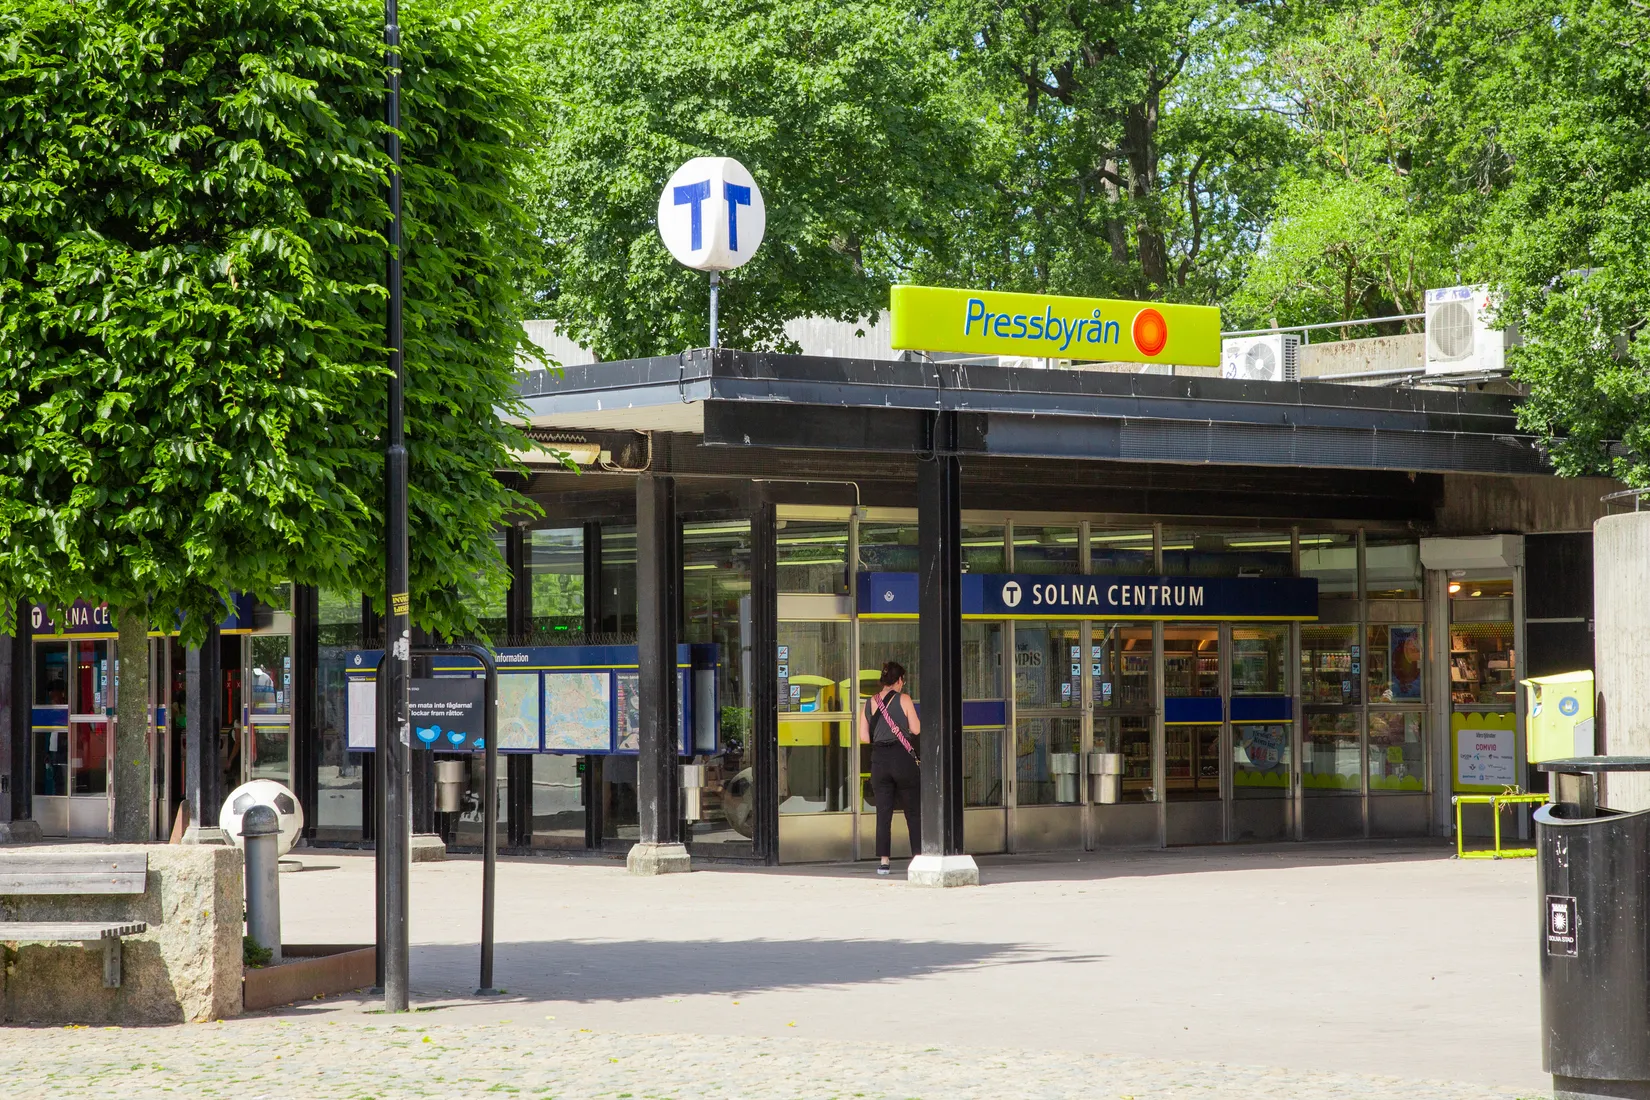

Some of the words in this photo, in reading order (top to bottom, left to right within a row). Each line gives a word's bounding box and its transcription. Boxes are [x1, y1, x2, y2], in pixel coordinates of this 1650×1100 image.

[673, 178, 711, 252] T
[722, 179, 751, 252] T
[964, 298, 1120, 351] Pressbyrån
[1032, 584, 1099, 606] SOLNA
[1107, 584, 1204, 606] CENTRUM
[446, 702, 473, 710] fåglarna!
